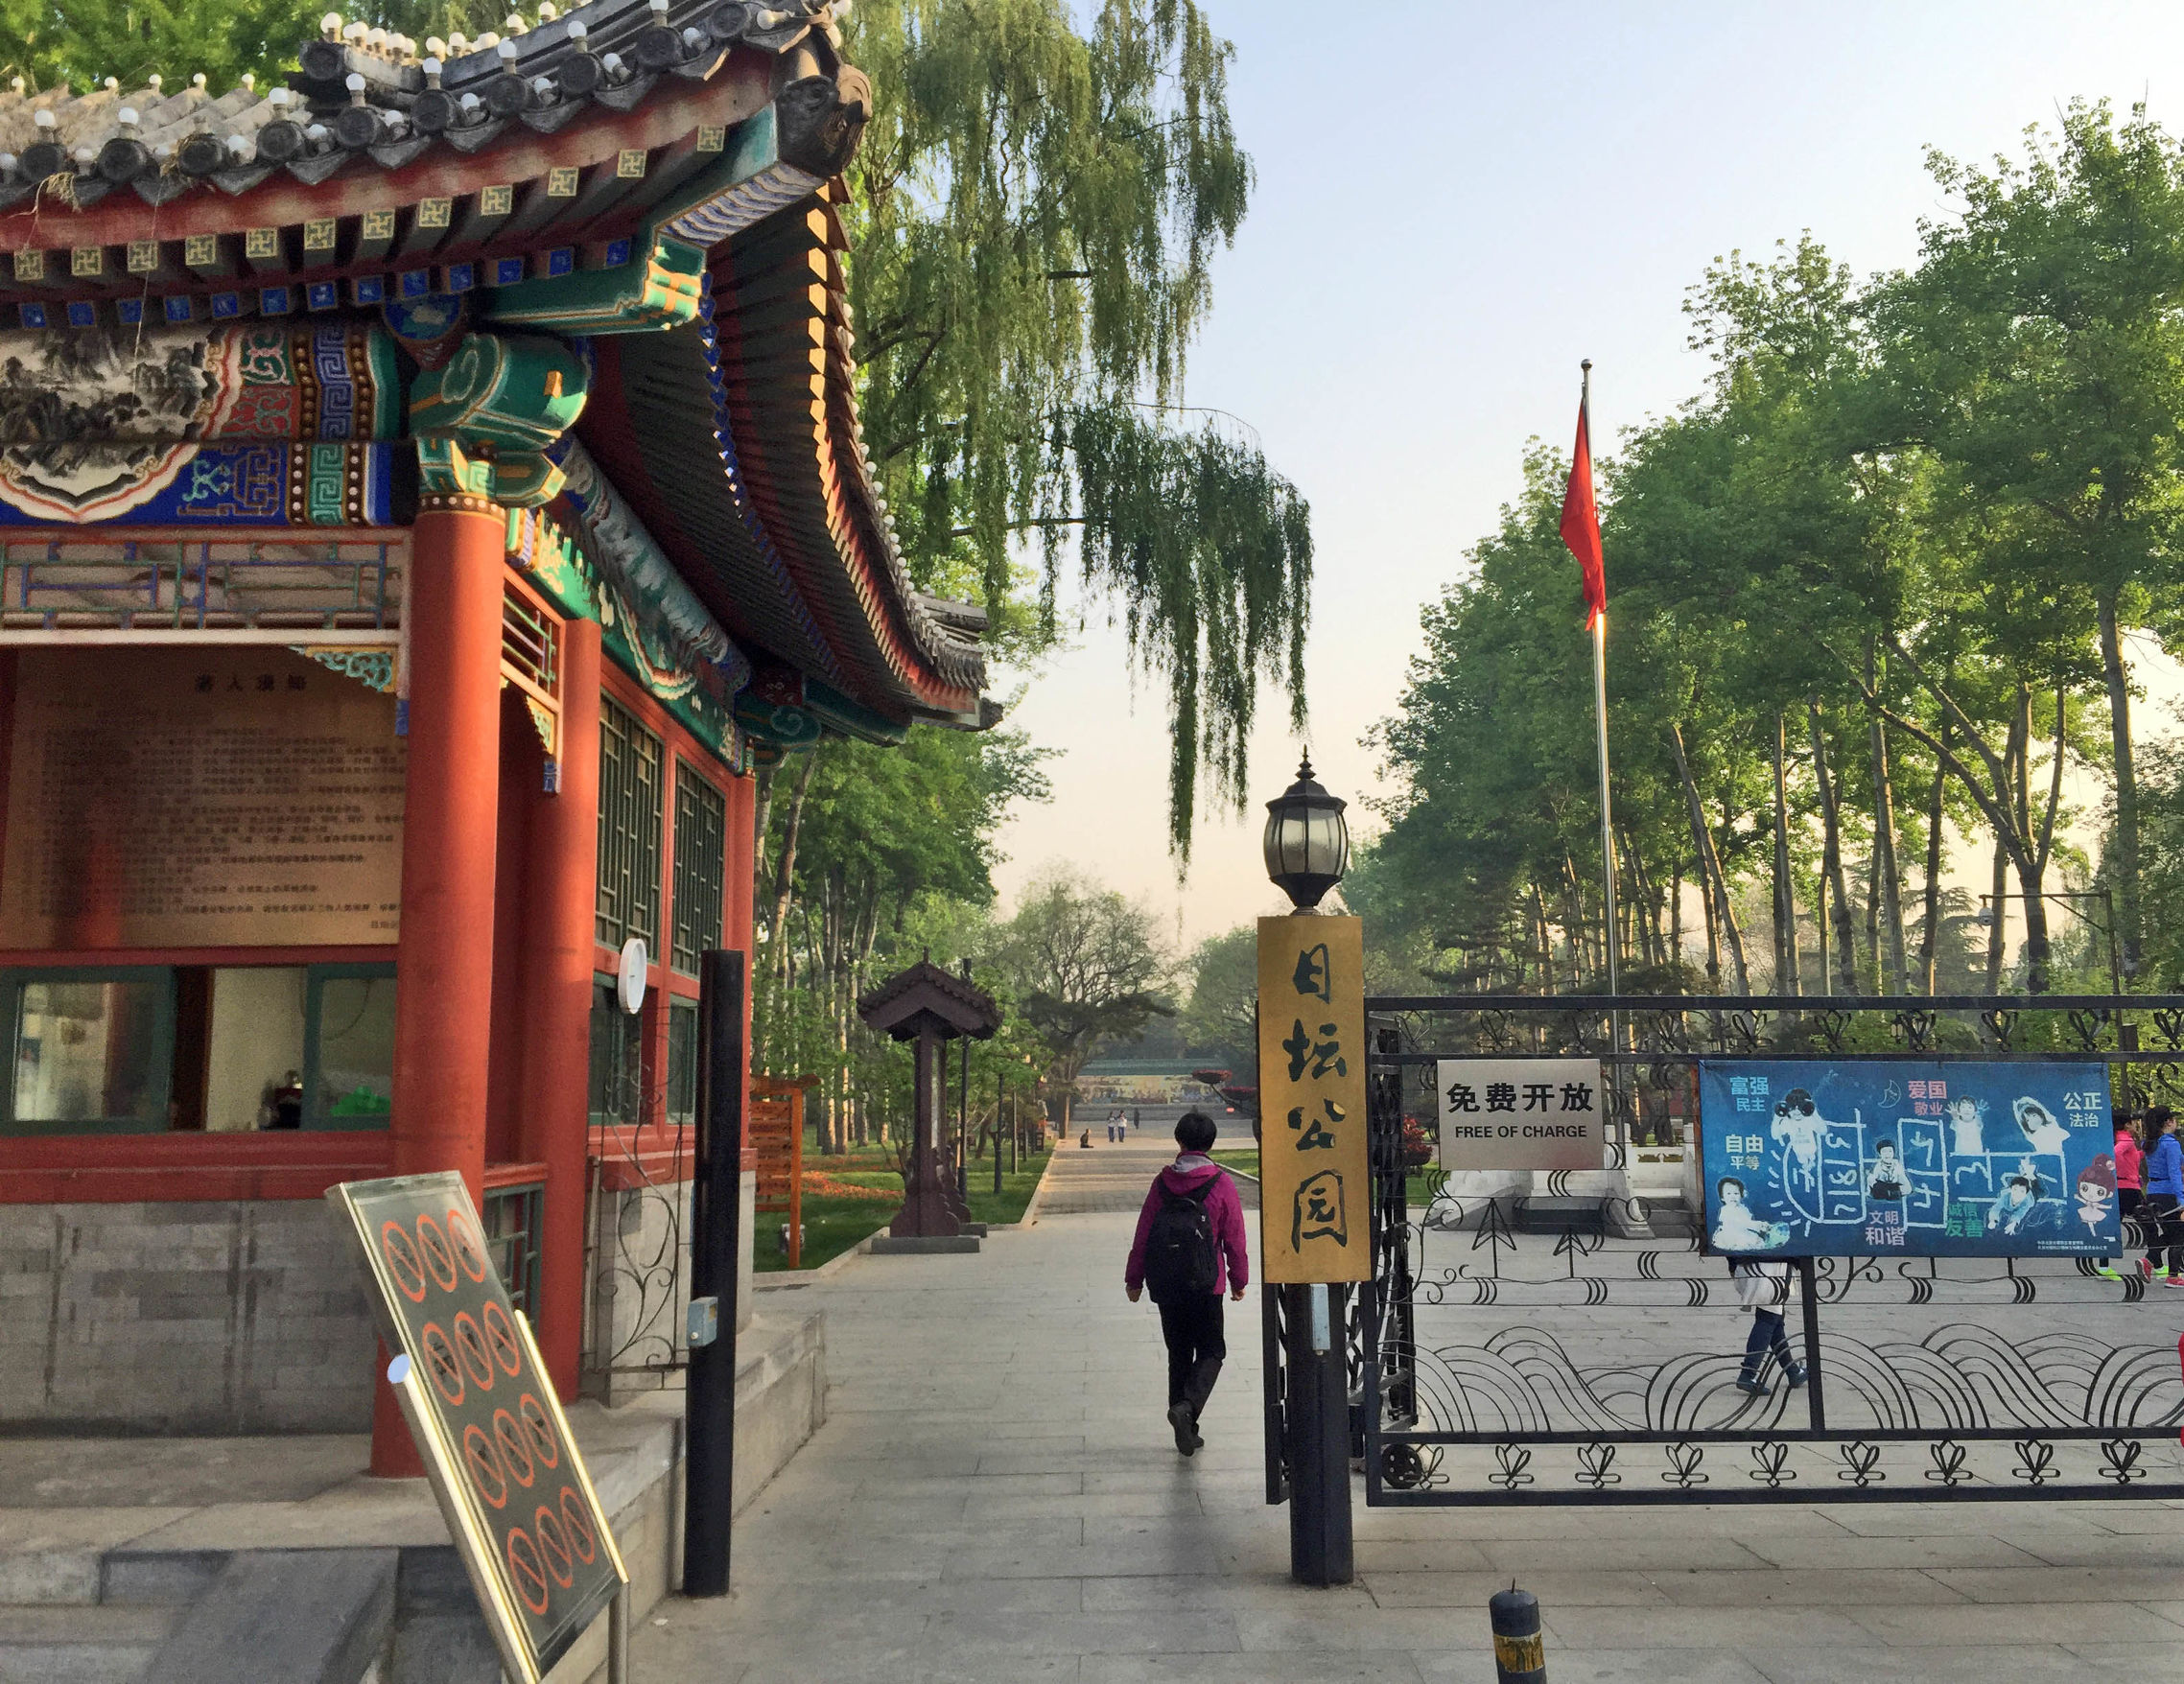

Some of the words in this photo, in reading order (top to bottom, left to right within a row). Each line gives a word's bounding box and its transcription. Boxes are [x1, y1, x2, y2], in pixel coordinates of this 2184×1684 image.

[1729, 1076, 1769, 1095] 富强
[1908, 1080, 1947, 1100] 爱国
[1282, 943, 1348, 1253] 日坛公园
[1446, 1082, 1593, 1112] 免费开放
[1736, 1097, 1766, 1111] 民主
[2063, 1091, 2102, 1111] 公正
[1914, 1102, 1943, 1115] 敬业
[2069, 1112, 2099, 1128] 法治
[1455, 1126, 1492, 1138] FREE
[1497, 1125, 1518, 1137] OF
[1522, 1125, 1587, 1137] CHARGE
[1726, 1134, 1763, 1154] 自由
[1730, 1156, 1760, 1170] 平等
[1869, 1210, 1898, 1225] 文明
[1948, 1203, 1978, 1217] 诚信
[1866, 1227, 1905, 1246] 和谐
[1945, 1218, 1984, 1237] 友善
